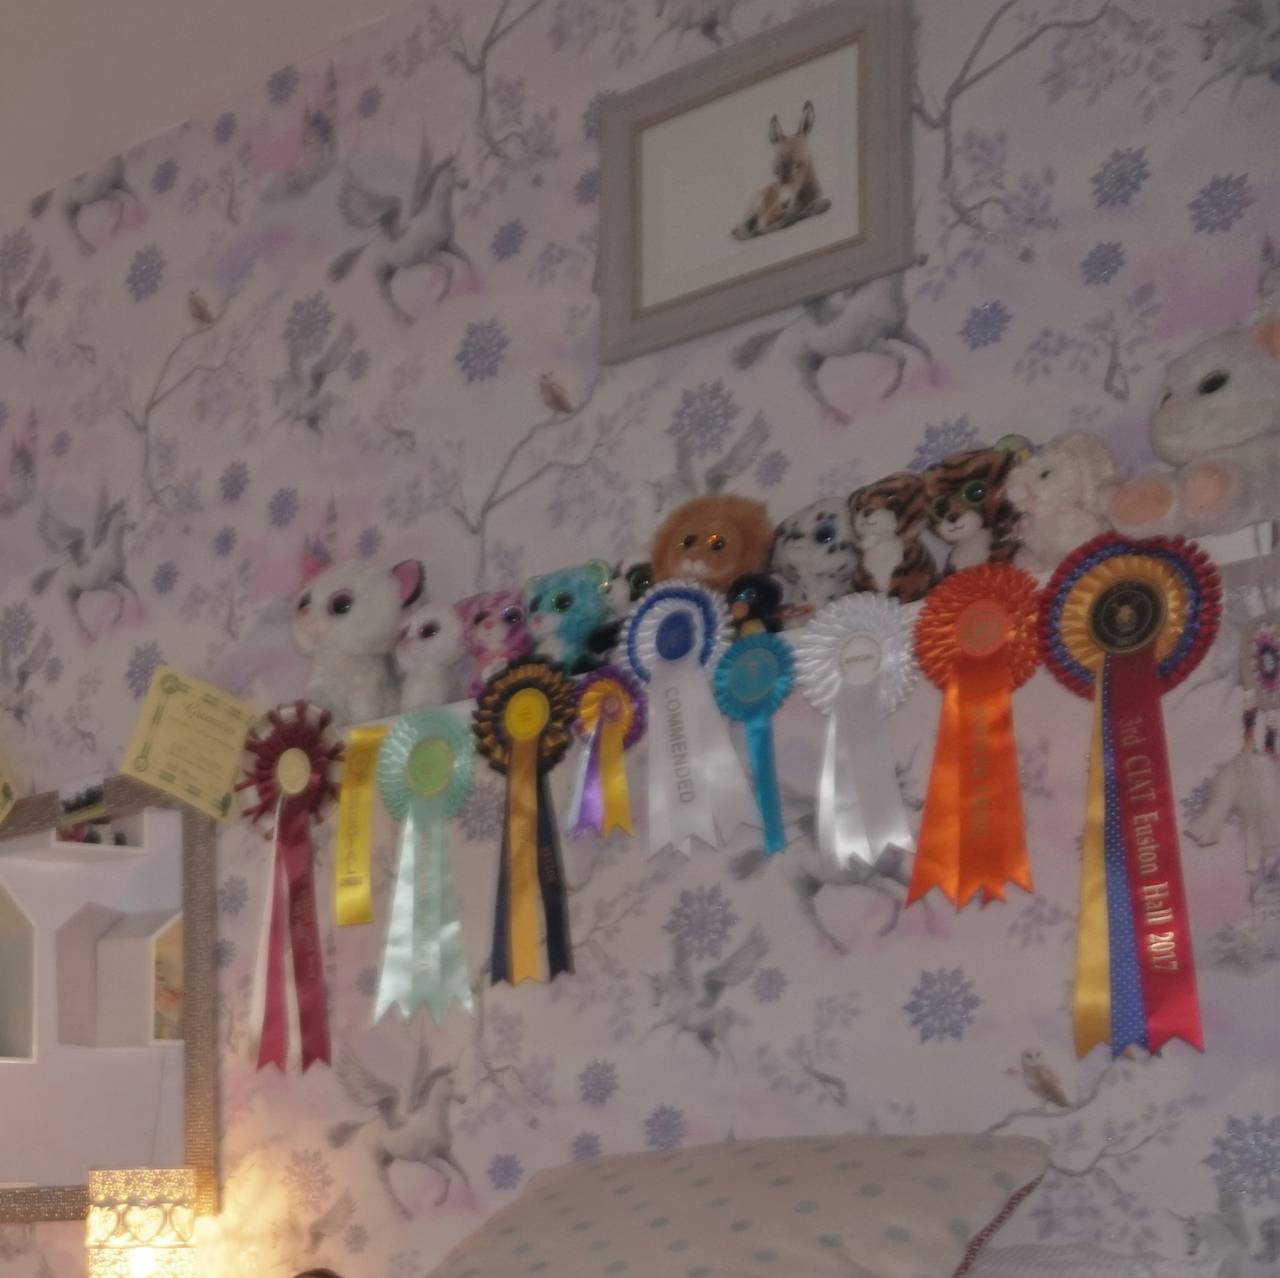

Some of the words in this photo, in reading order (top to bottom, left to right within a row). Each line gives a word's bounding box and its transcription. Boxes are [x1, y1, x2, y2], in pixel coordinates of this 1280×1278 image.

[664, 686, 696, 804] COMMENDED
[1119, 715, 1147, 747] 3rd
[1133, 810, 1163, 876] Euston
[1142, 881, 1176, 926] Hall
[1147, 931, 1179, 972] 2017
